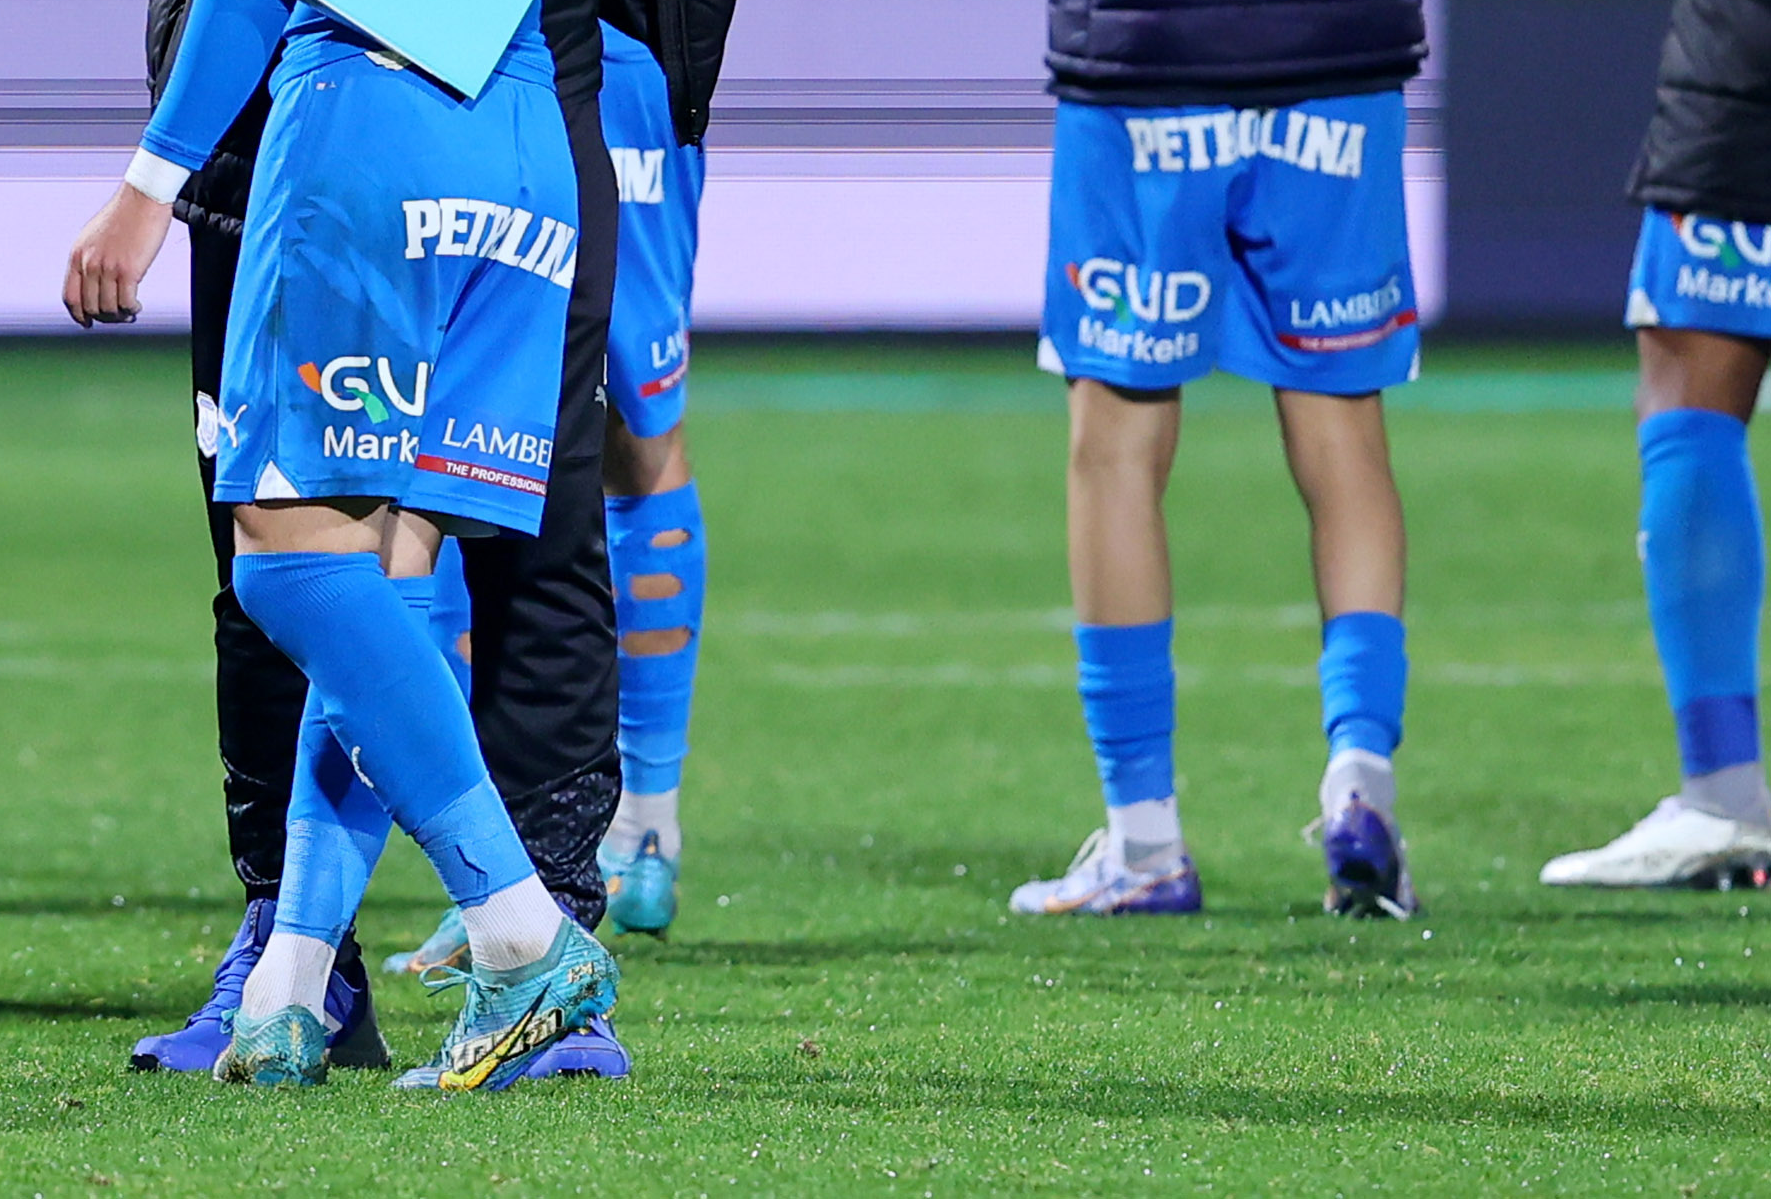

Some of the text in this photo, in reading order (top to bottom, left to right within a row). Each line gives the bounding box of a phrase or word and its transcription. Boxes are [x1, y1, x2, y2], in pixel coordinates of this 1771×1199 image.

[1126, 108, 1367, 178] PETROLINA
[1078, 316, 1200, 364] Markets
[445, 461, 469, 476] THE
